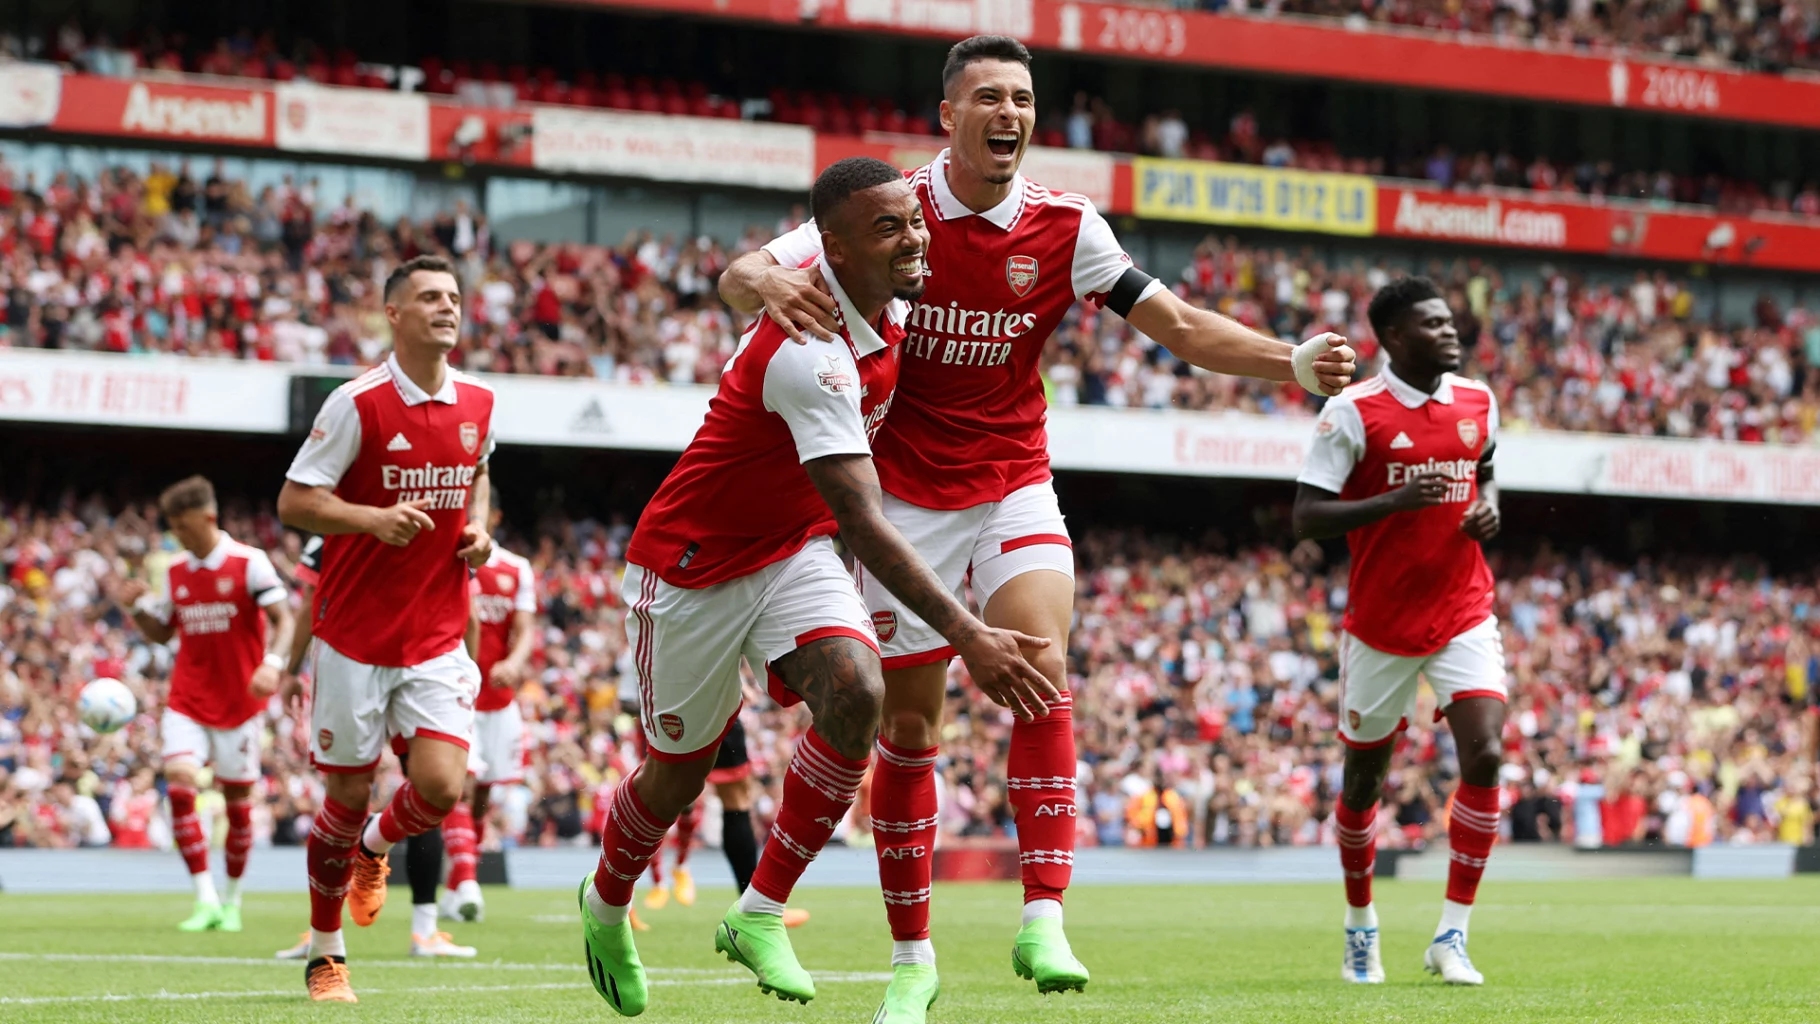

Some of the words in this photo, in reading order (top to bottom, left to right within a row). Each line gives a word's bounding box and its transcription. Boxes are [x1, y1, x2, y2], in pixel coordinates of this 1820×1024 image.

[1098, 6, 1186, 56] 2003
[1641, 65, 1719, 111] 2004
[122, 82, 266, 140] Arsenal
[1393, 189, 1567, 248] Arsenal.com
[1010, 261, 1035, 270] Arsenal
[911, 300, 1037, 338] mirates
[905, 331, 939, 360] FLY
[941, 339, 1012, 366] BETTER
[381, 462, 476, 489] Emirate
[1387, 457, 1477, 486] Emirate
[1034, 803, 1077, 818] AFC
[881, 845, 925, 860] AFC
